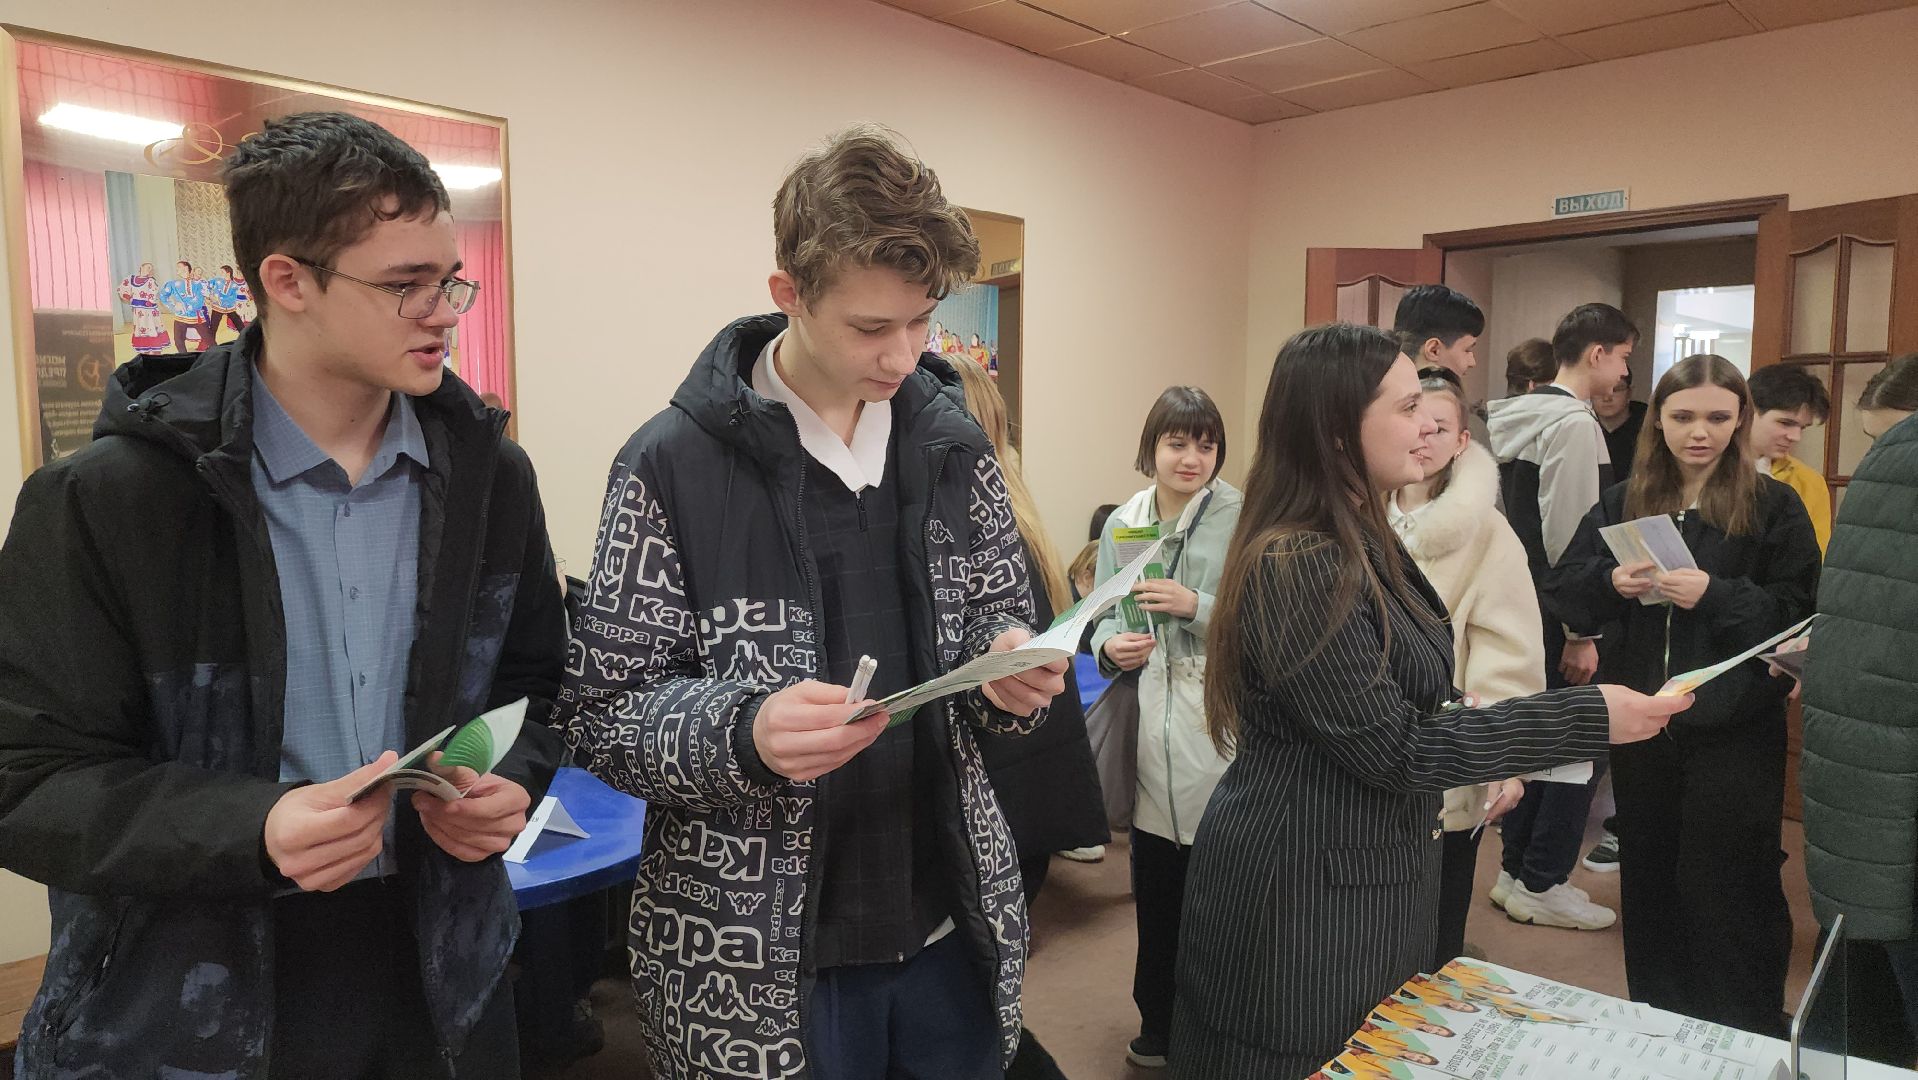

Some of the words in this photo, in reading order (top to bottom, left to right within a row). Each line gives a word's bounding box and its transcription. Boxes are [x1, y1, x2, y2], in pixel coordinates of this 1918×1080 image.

[1558, 192, 1621, 213] ВЫХОД
[583, 614, 651, 645] Kappa
[770, 878, 785, 941] Kappa
